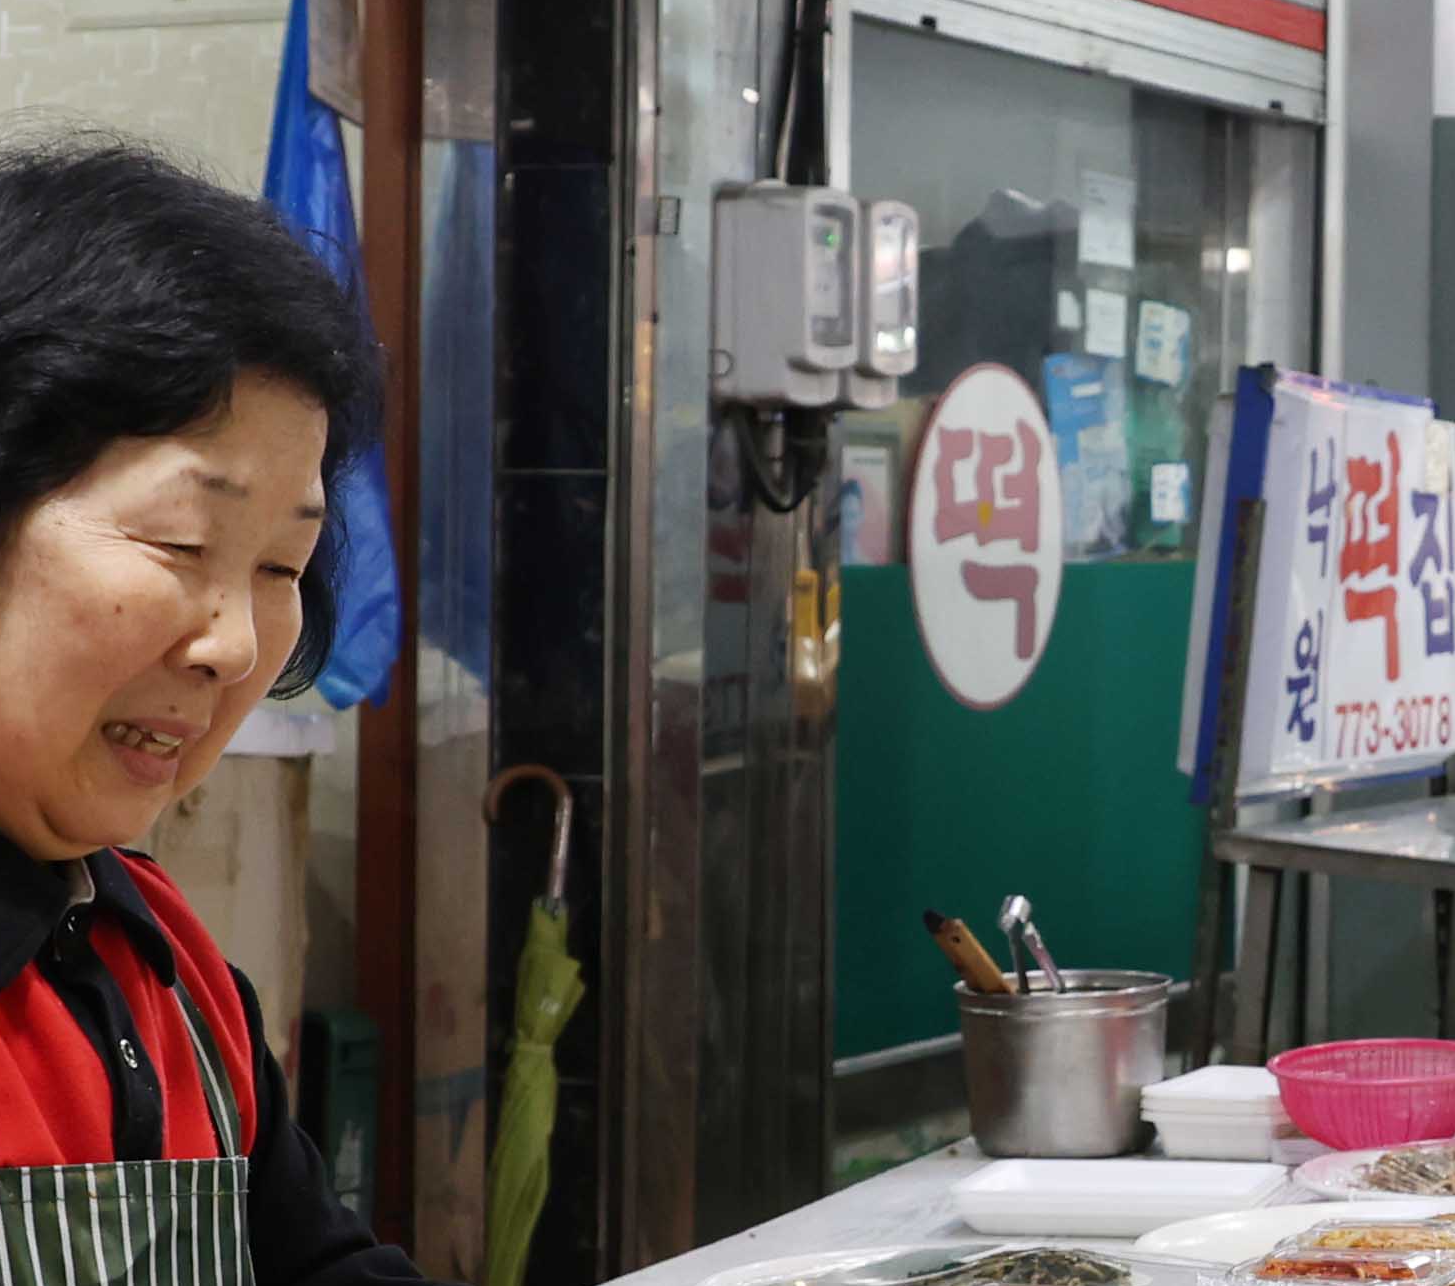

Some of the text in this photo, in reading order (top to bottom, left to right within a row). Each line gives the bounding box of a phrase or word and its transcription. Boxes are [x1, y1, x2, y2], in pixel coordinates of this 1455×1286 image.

[933, 417, 1042, 661] 떡
[1286, 436, 1337, 743] 낙원
[1338, 430, 1455, 682] 떡집
[1335, 696, 1452, 759] 773-3078
